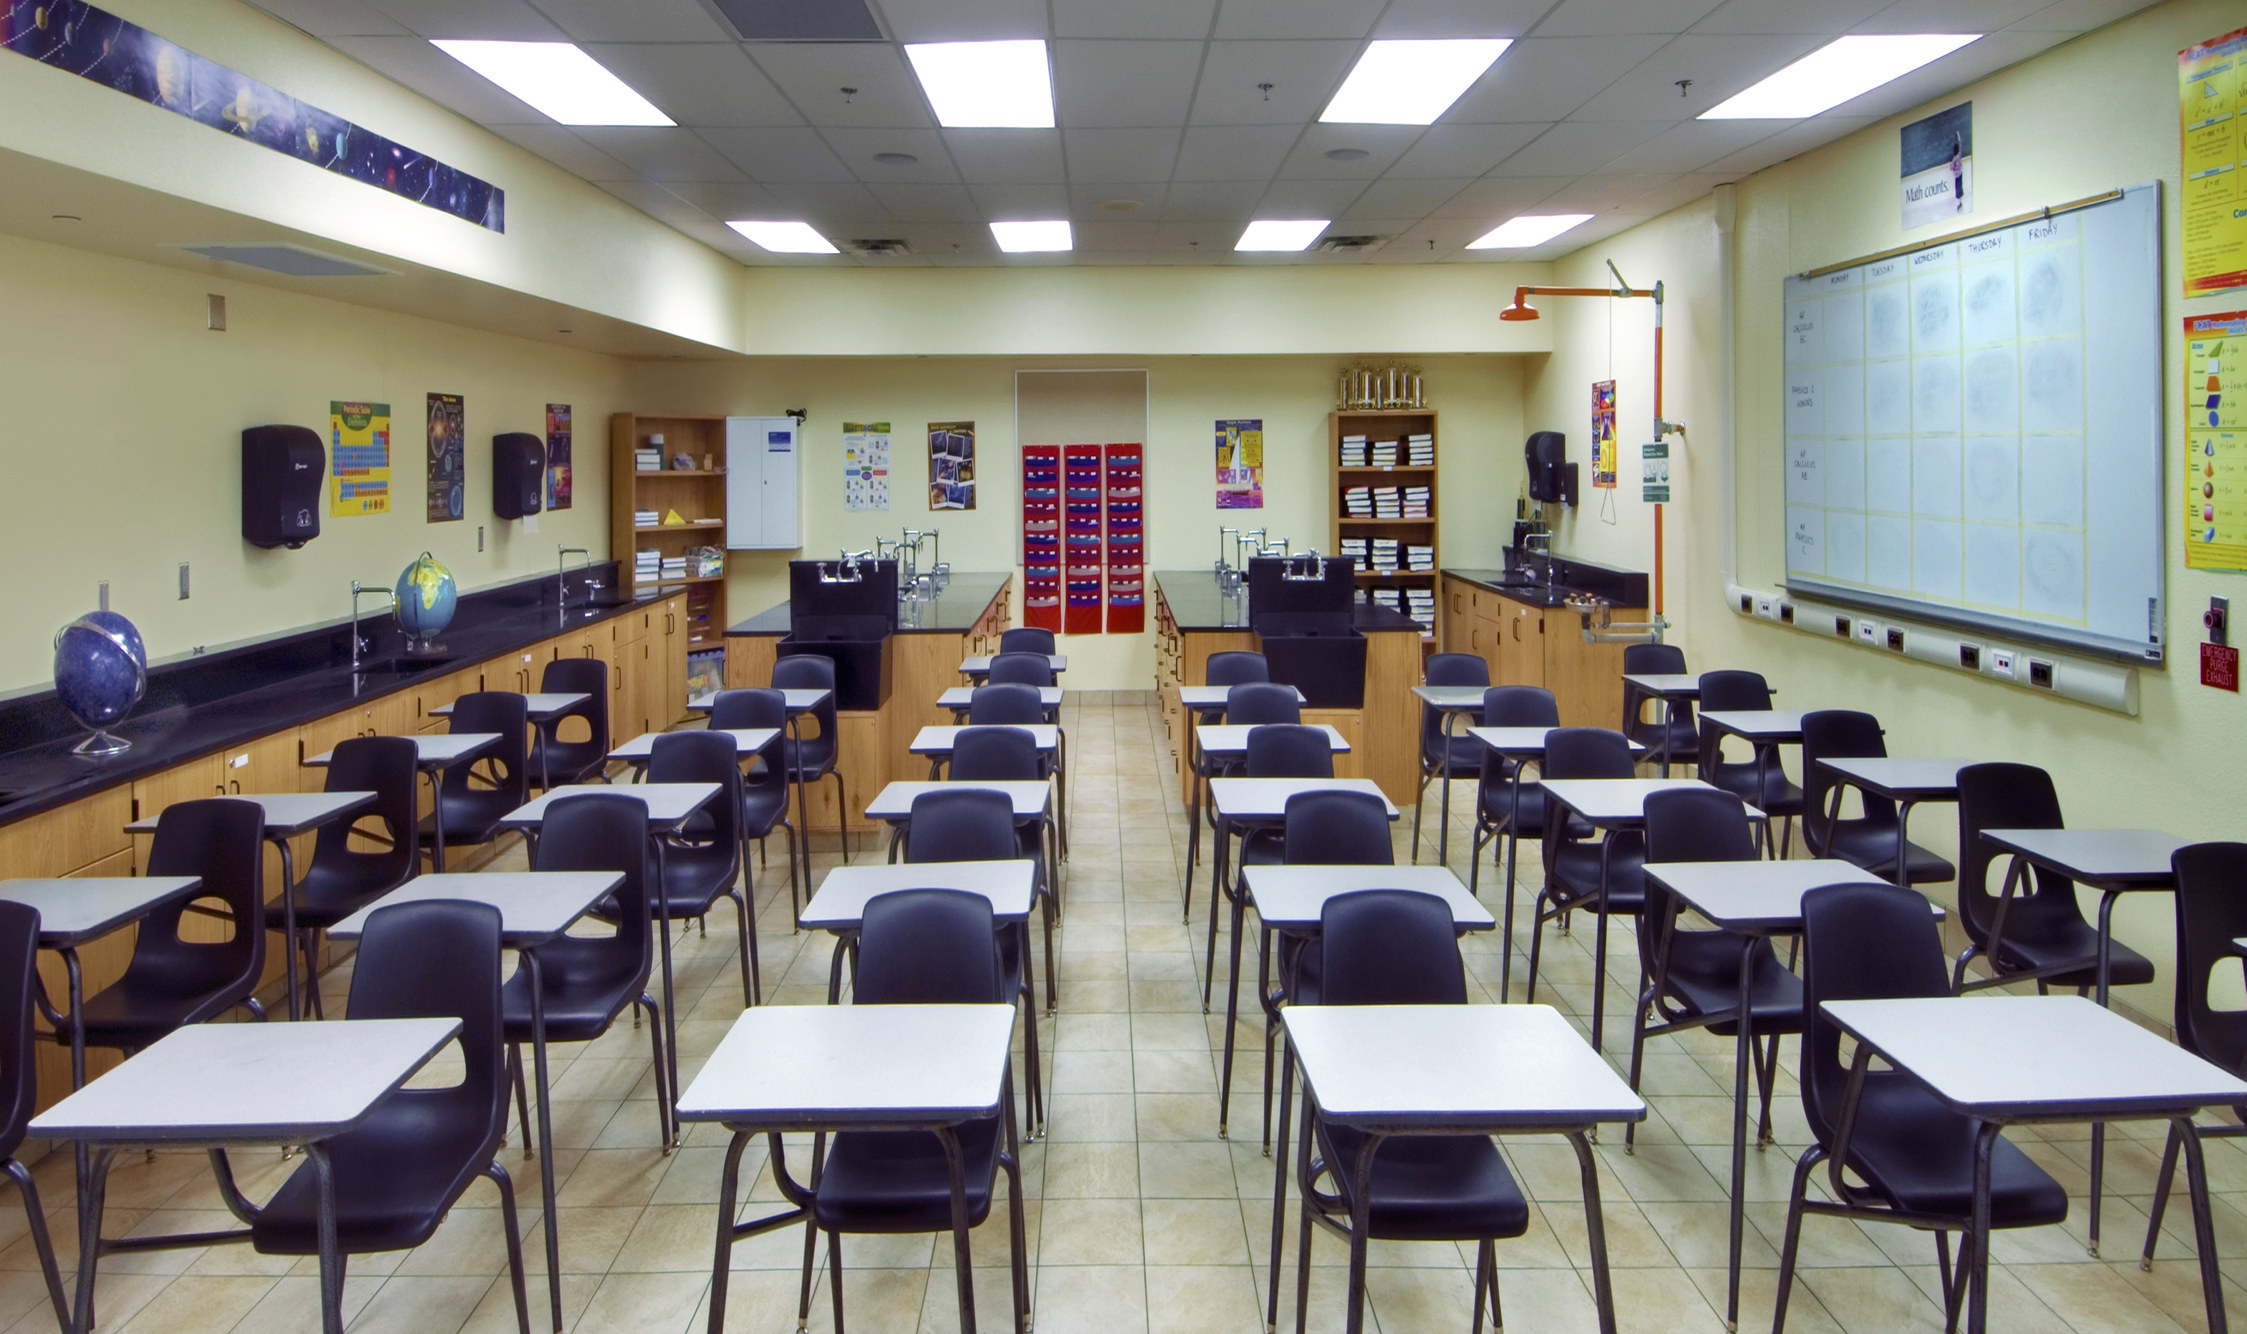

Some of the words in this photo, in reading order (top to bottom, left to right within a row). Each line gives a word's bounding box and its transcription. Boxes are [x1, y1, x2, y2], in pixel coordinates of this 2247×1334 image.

[1906, 184, 1923, 204] Math
[2028, 223, 2058, 240] FRIDAY
[1968, 236, 2001, 253] THURSDAY
[1872, 263, 1894, 278] TUESDAY
[2202, 644, 2237, 662] EMERGENCY
[2210, 658, 2228, 673] PURGE
[2206, 670, 2232, 686] EXHAUST
